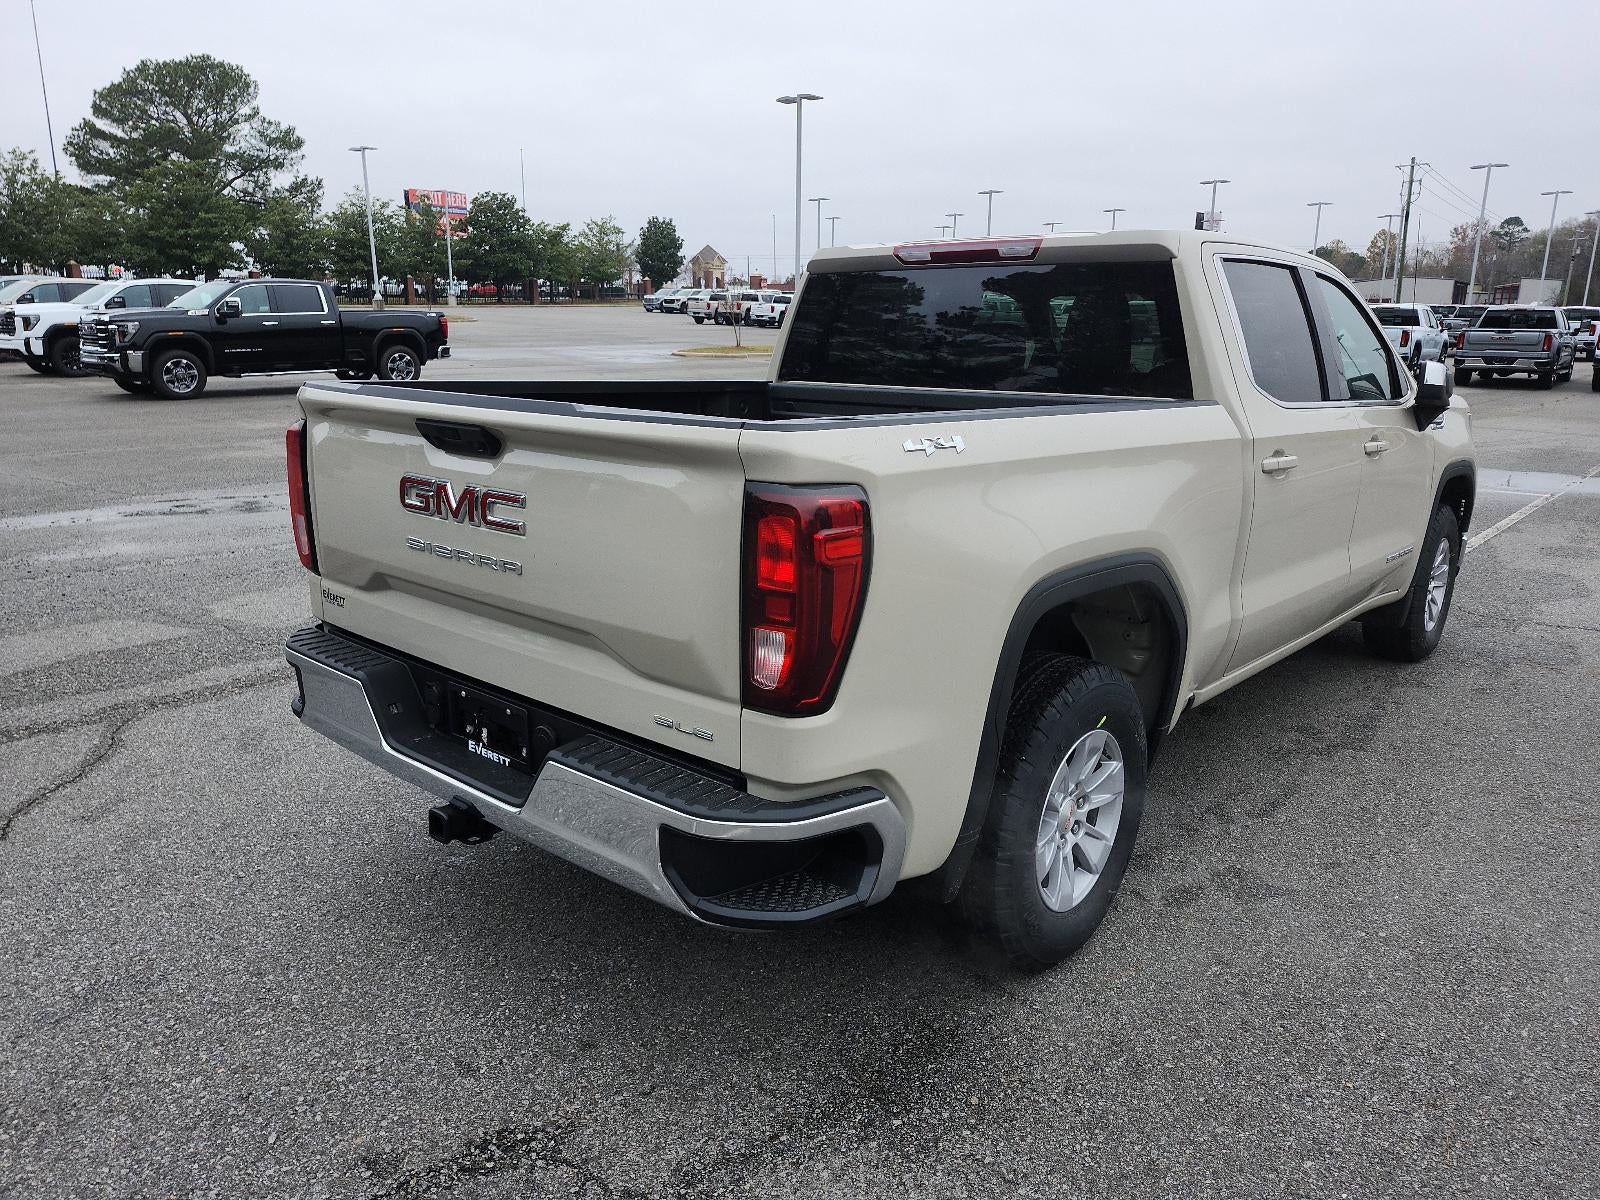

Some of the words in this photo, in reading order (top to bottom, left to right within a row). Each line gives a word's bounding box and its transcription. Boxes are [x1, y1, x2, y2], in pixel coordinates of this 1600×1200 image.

[400, 472, 527, 538] GMC
[406, 535, 523, 576] SIERRA
[322, 588, 346, 605] EVERETT
[653, 714, 714, 742] SLE
[468, 739, 511, 767] EVERETT
